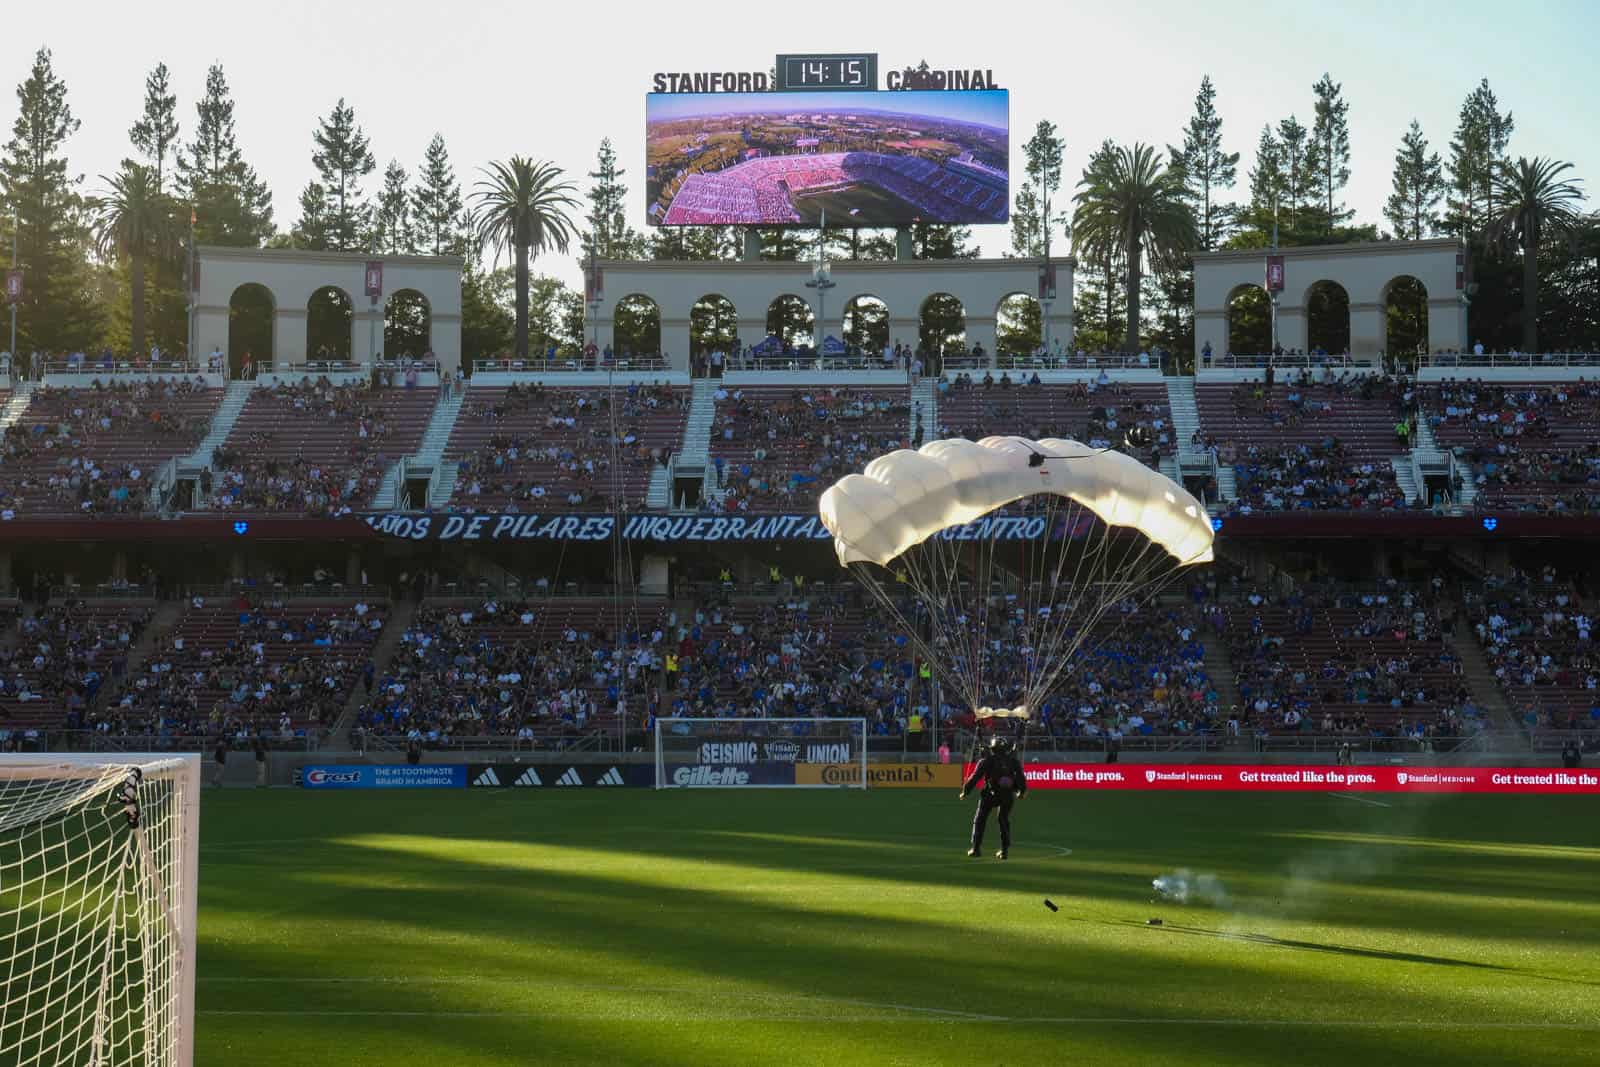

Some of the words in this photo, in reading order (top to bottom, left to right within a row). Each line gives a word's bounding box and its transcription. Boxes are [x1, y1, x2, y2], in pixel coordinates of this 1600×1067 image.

[802, 60, 862, 84] 14:15
[653, 72, 767, 92] STANFORD
[887, 70, 998, 90] CARDINAL
[440, 515, 491, 539] DE
[493, 515, 613, 540] PILARES
[702, 741, 758, 764] SEISMIC
[806, 743, 850, 764] UNION
[307, 769, 361, 784] Crest
[375, 767, 390, 776] THE
[401, 767, 453, 776] TOOTHPASTE
[673, 765, 749, 785] Gillette
[821, 765, 919, 785] Contnental
[1052, 769, 1073, 781] like
[1075, 769, 1094, 781] the
[1096, 772, 1125, 784] pros.
[1156, 772, 1186, 781] Stanford
[1190, 773, 1222, 781] MEDICINE
[1239, 771, 1258, 782] Get
[1260, 771, 1300, 782] treated
[1302, 771, 1324, 782] like
[1326, 771, 1344, 783] the
[1347, 774, 1376, 786] pros.
[1408, 774, 1438, 784] Stanford
[1442, 776, 1475, 784] MEDICINE
[375, 777, 403, 785] BRAND
[416, 777, 453, 785] AMERICA
[1491, 774, 1511, 785] Get
[1514, 774, 1553, 785] treated
[1555, 774, 1577, 785] like
[1579, 774, 1598, 786] the
